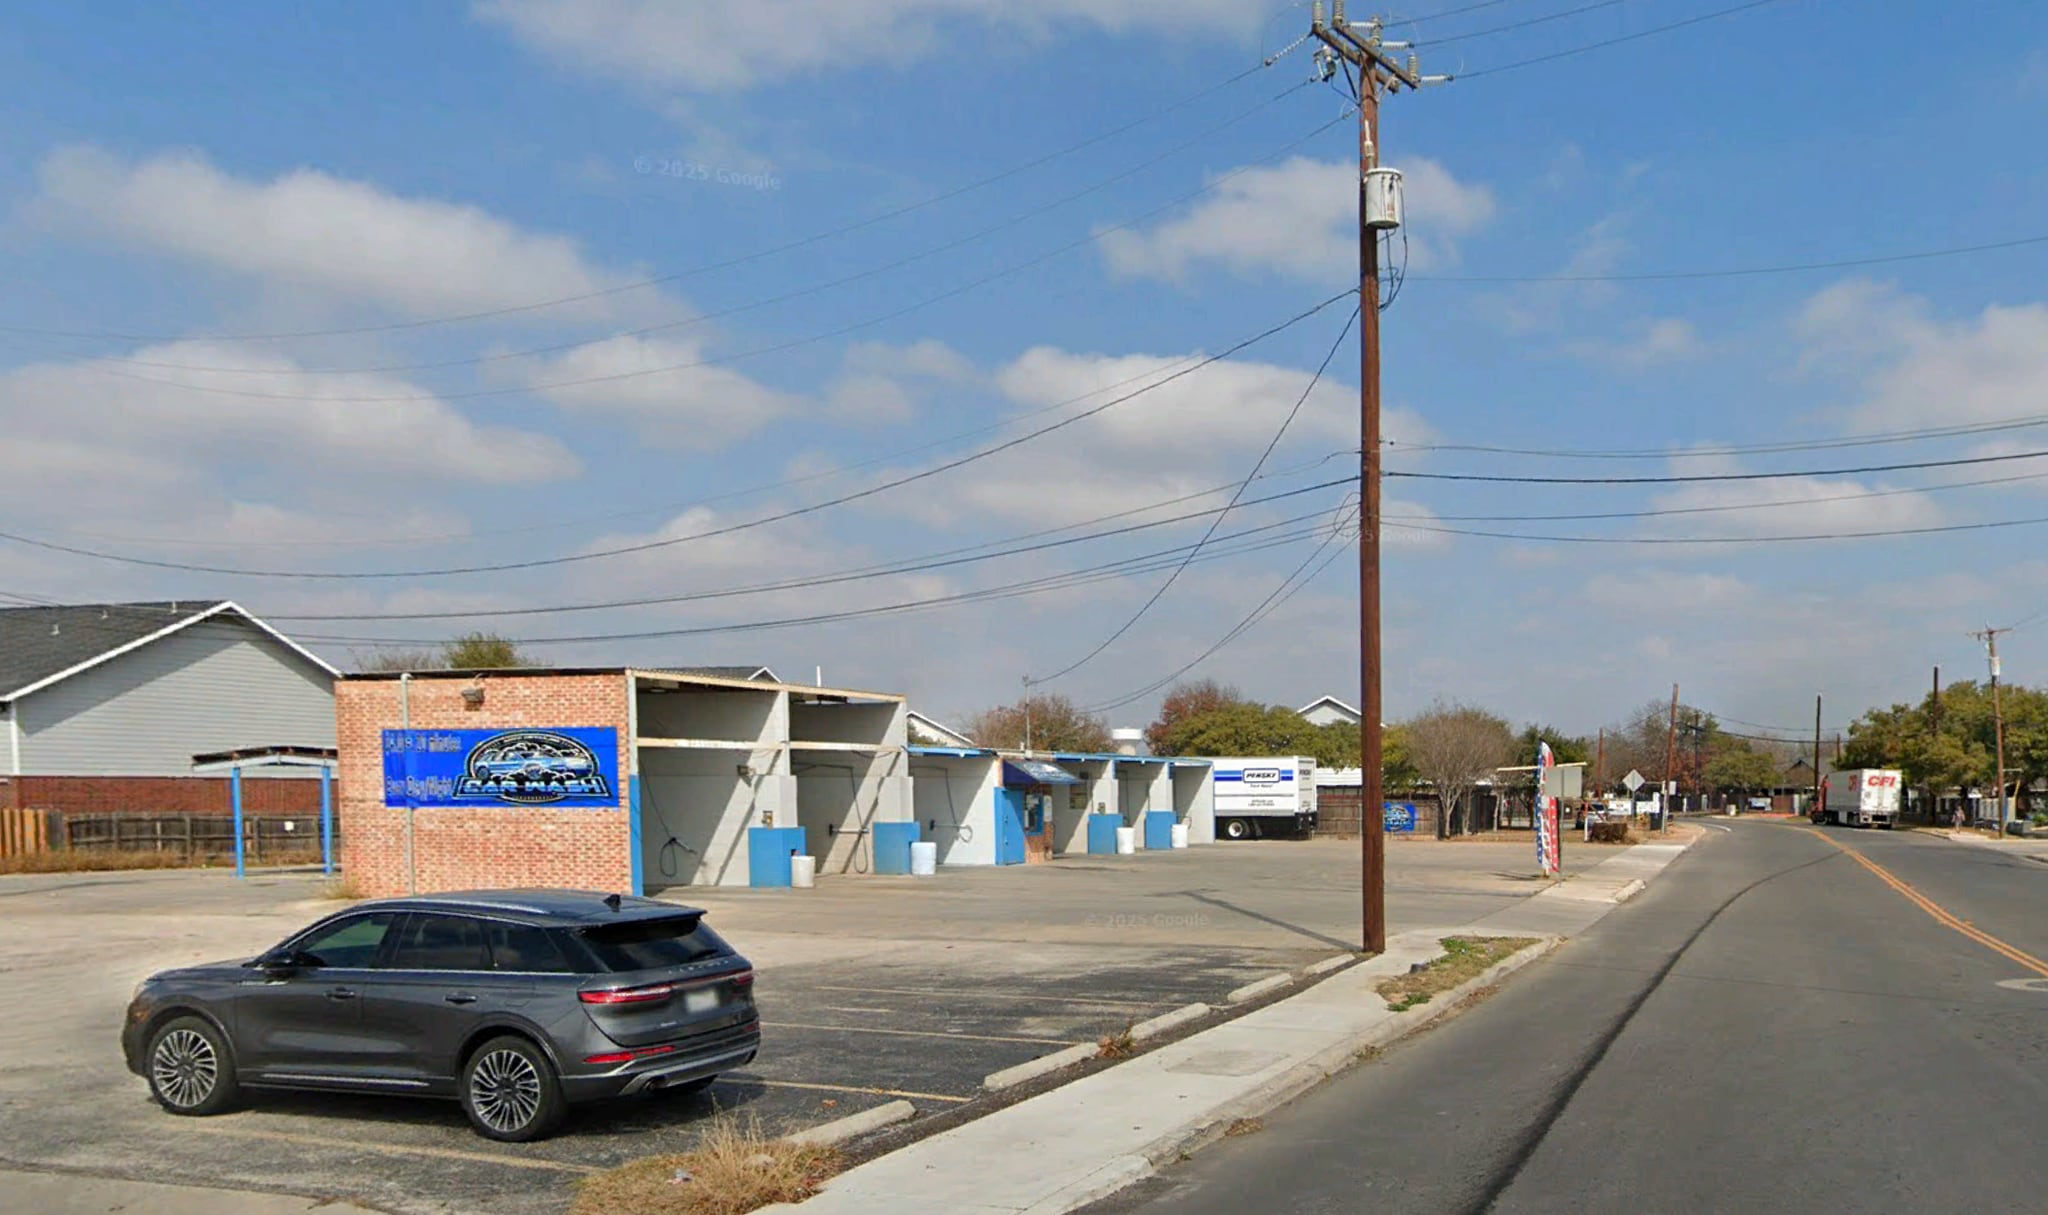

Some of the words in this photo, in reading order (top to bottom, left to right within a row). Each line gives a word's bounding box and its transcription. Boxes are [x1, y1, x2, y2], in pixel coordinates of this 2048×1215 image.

[464, 780, 517, 793] CAR
[525, 779, 602, 793] WASH
[1867, 775, 1896, 787] CFI
